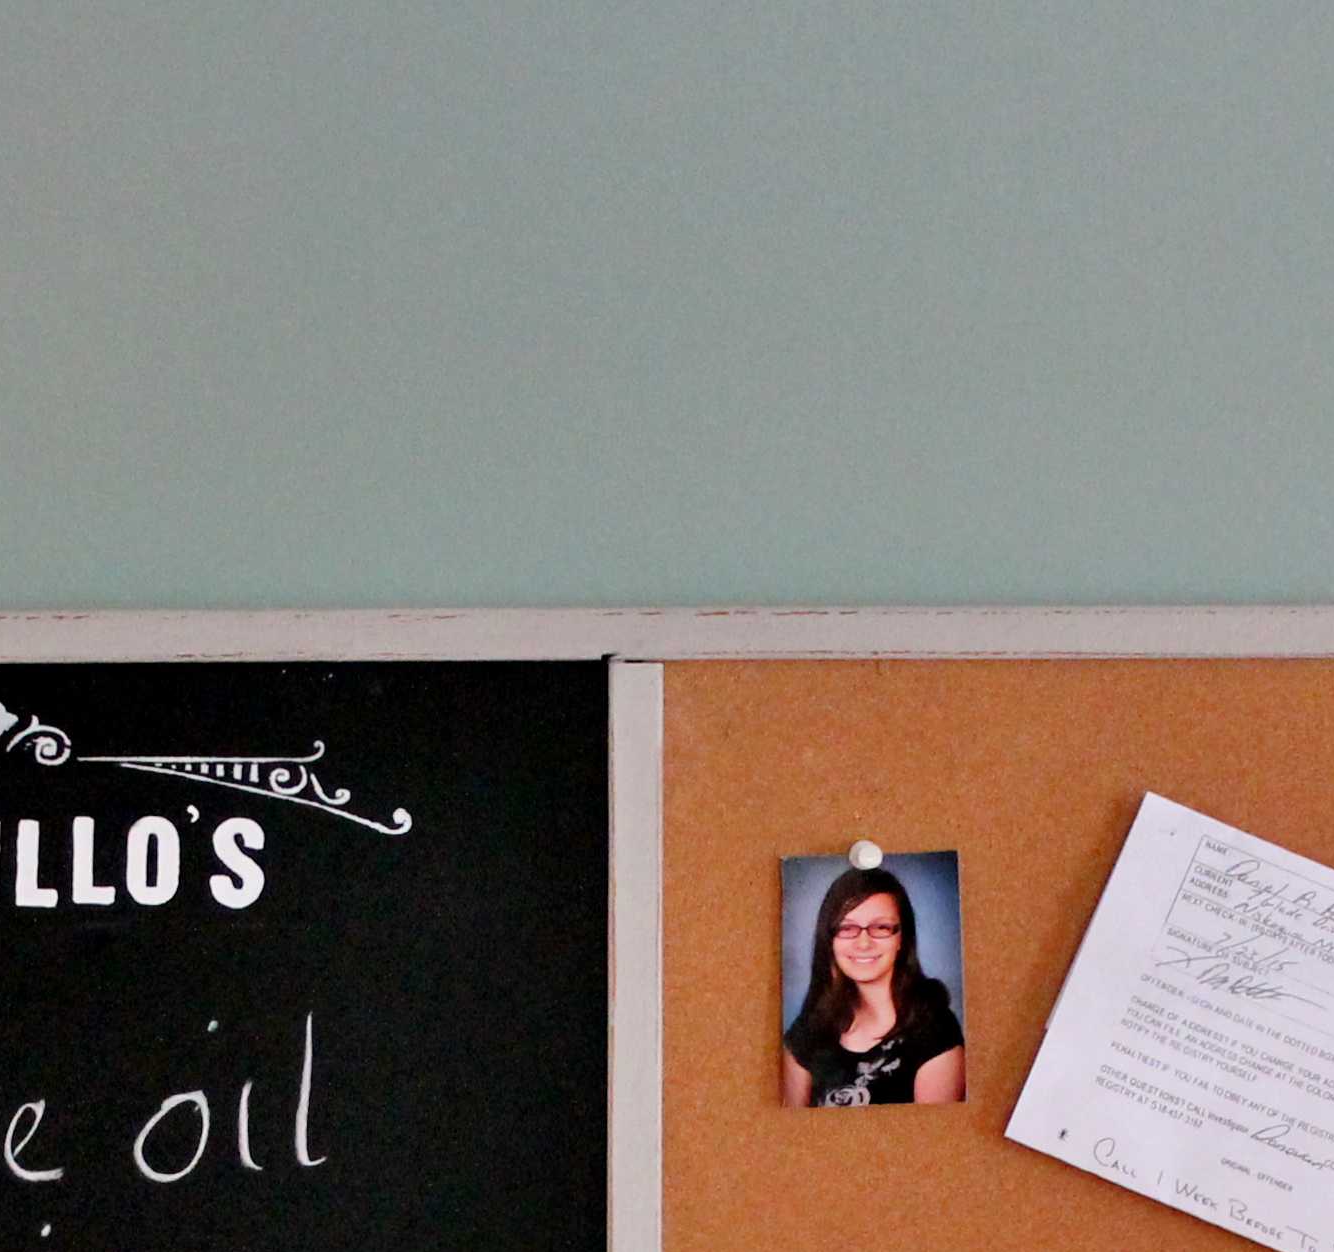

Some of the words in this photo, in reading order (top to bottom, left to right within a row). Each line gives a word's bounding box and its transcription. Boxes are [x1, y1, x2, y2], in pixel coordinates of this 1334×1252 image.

[1119, 1017, 1151, 1037] NOTIFY
[1151, 1031, 1168, 1044] THE
[1167, 1038, 1215, 1065] REGISTRY
[1125, 1007, 1143, 1019] YOU
[1142, 1014, 1163, 1028] CAN
[1184, 1032, 1198, 1044] AN
[1198, 1038, 1238, 1061] ADDRESS
[1237, 1055, 1273, 1076] CHANGE
[1273, 1070, 1287, 1081] AT
[1287, 1075, 1304, 1089] THE
[1130, 994, 1164, 1015] CHANGE
[1166, 1010, 1179, 1022] OF
[1238, 1042, 1259, 1057] YOU
[1259, 1050, 1294, 1071] CHANGE
[1296, 1066, 1321, 1082] YOUR
[1213, 1005, 1233, 1019] AND
[1232, 1013, 1253, 1027] DATE
[1265, 1026, 1282, 1039] THE
[1282, 1034, 1318, 1055] DOTTED
[133, 1011, 327, 1183] oil
[1094, 1076, 1136, 1100] REGISTRY
[1136, 1093, 1150, 1105] AT
[1099, 1063, 1128, 1082] OTHER
[1128, 1076, 1186, 1107] QUESTIONS?
[1186, 1101, 1207, 1116] CALL
[1173, 1068, 1191, 1082] YOU
[1191, 1076, 1210, 1090] FAIL
[1212, 1085, 1225, 1097] TO
[1223, 1090, 1248, 1106] OBEY
[1247, 1100, 1265, 1113] ANY
[1266, 1107, 1278, 1118] OF
[1280, 1113, 1295, 1126] THE
